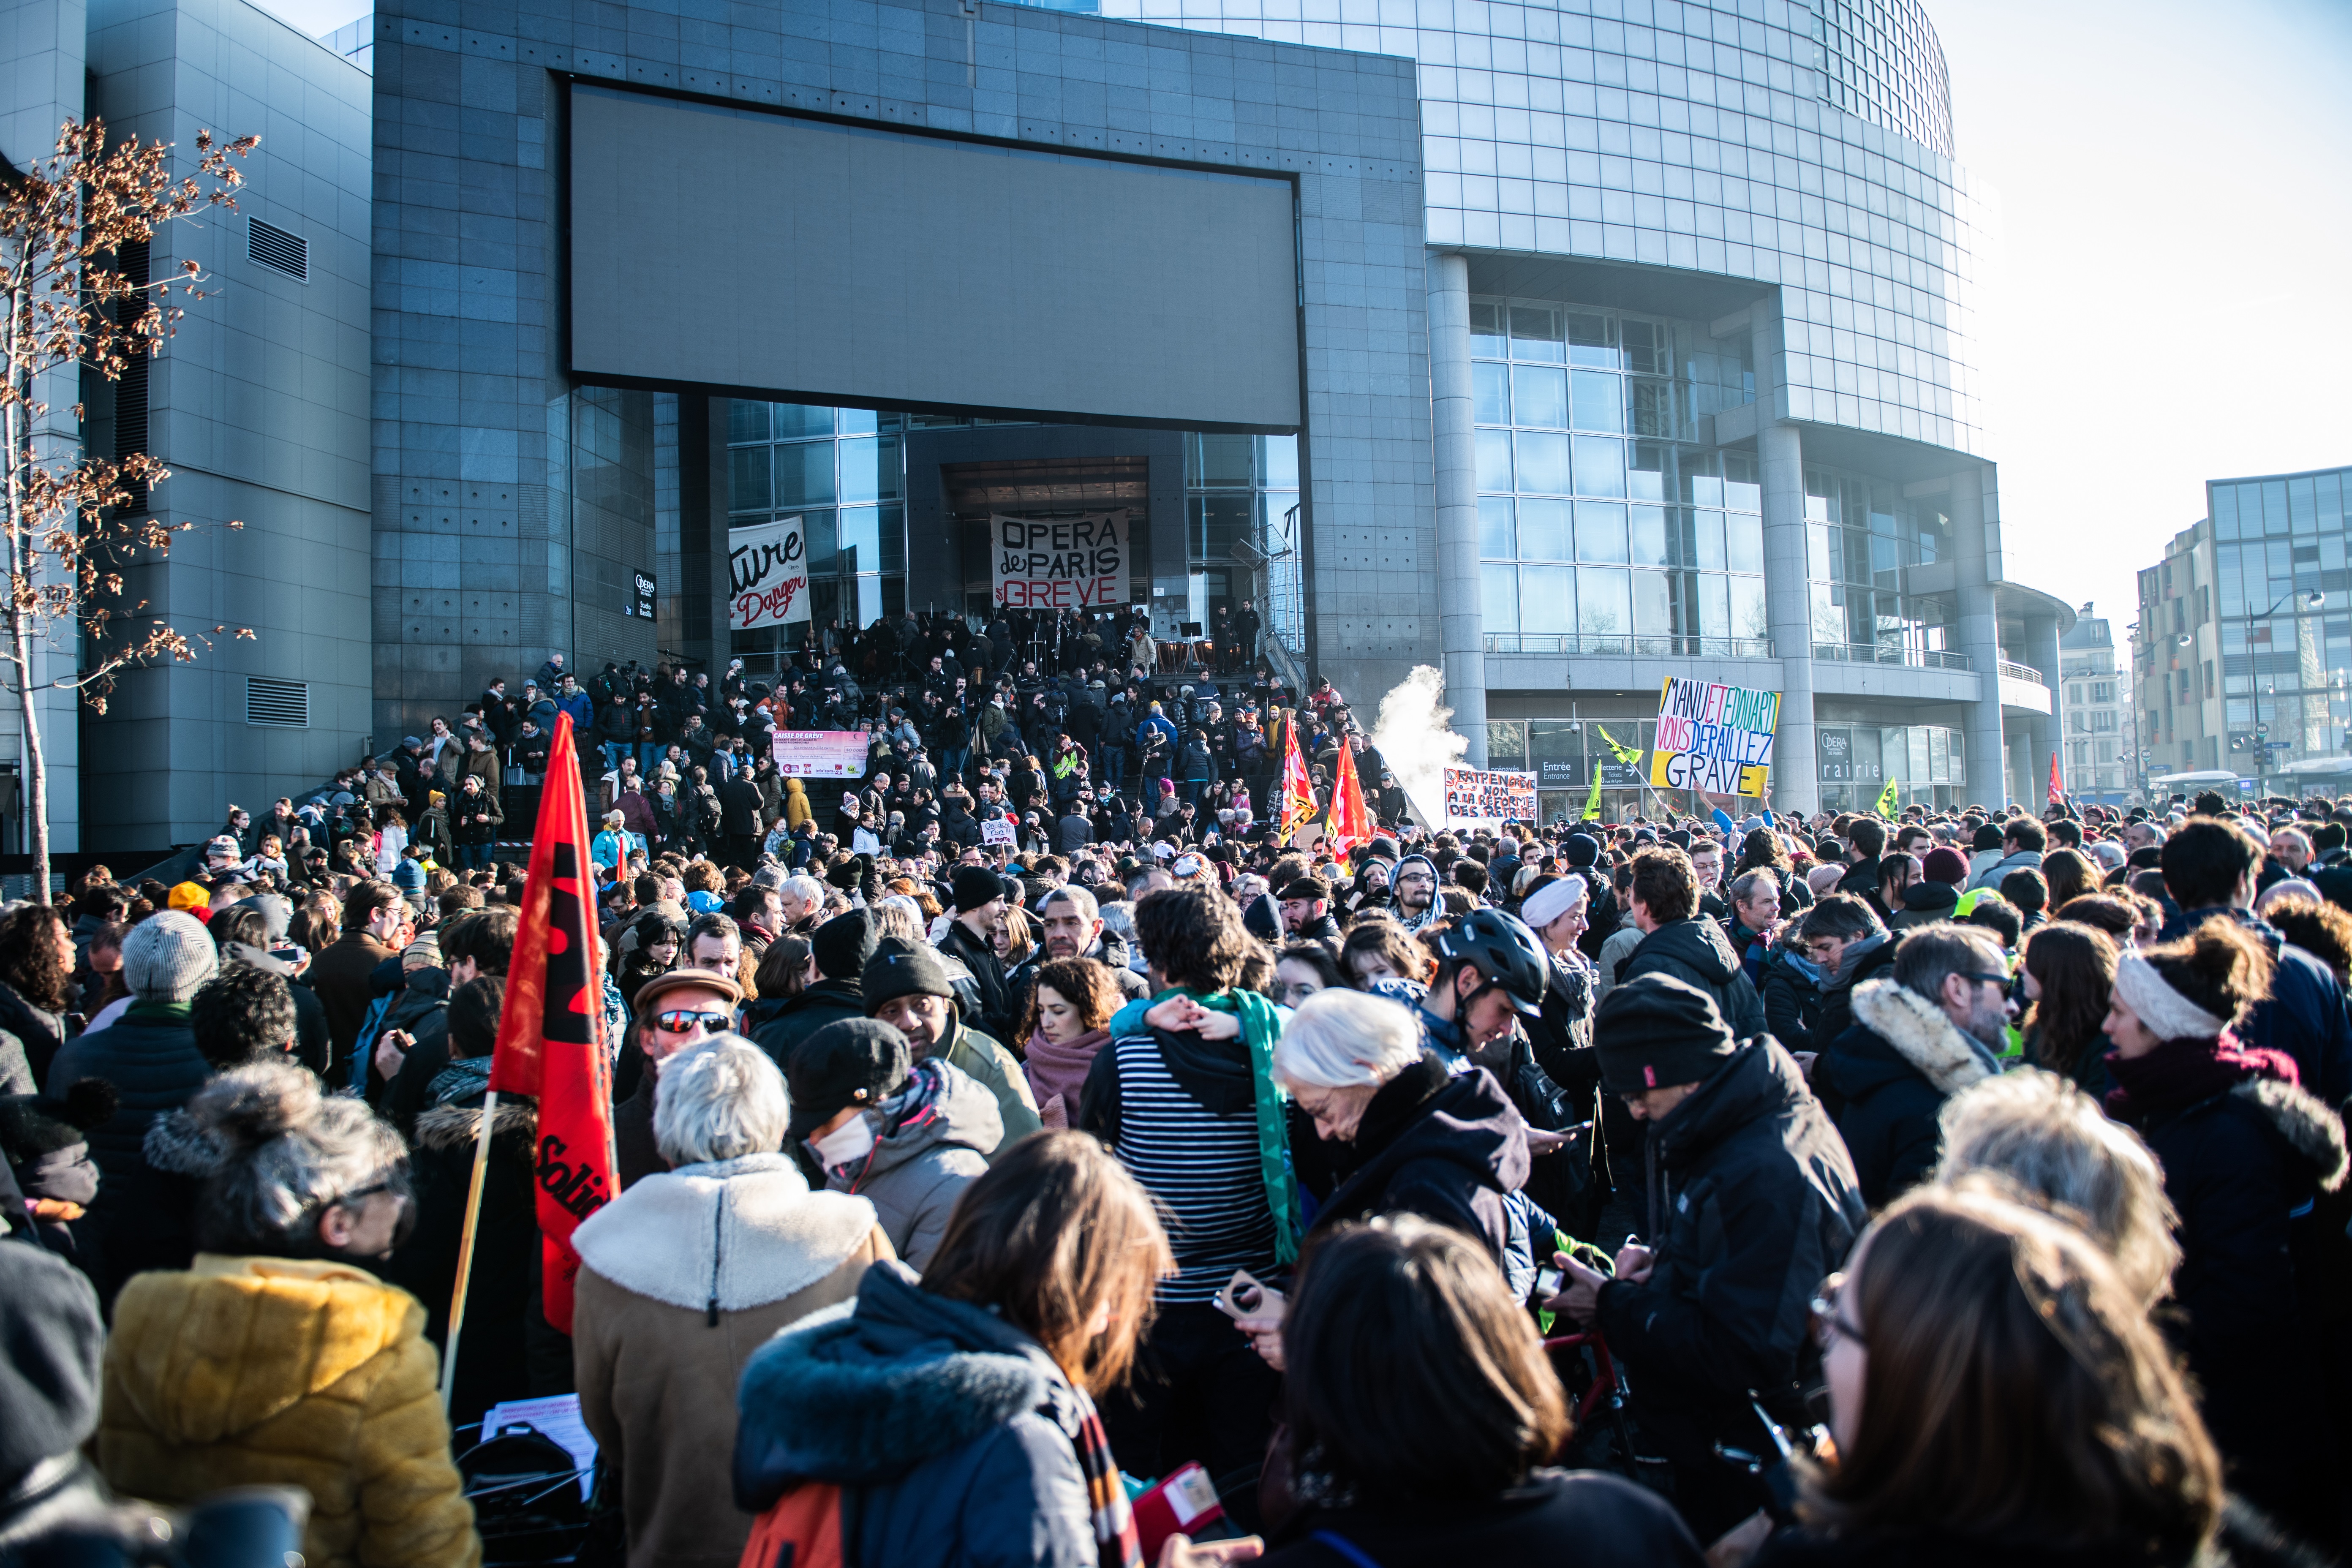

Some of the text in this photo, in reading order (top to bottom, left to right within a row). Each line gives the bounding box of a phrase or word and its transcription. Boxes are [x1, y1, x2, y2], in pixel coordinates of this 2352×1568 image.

[1002, 518, 1118, 550] OPERA
[1000, 547, 1120, 579] de PARIS
[640, 601, 651, 610] Studio
[737, 576, 806, 627] Danger
[996, 576, 1116, 607] en GREVE
[640, 608, 652, 618] Bastille
[1661, 678, 1778, 736] MANU ET EDOUARD
[1658, 715, 1773, 766] VOUS DÉRAILLEZ
[1821, 733, 1847, 750] OPÉRA
[1543, 762, 1571, 771] Entrée
[1666, 753, 1756, 794] GRAVE
[1483, 785, 1509, 797] NON
